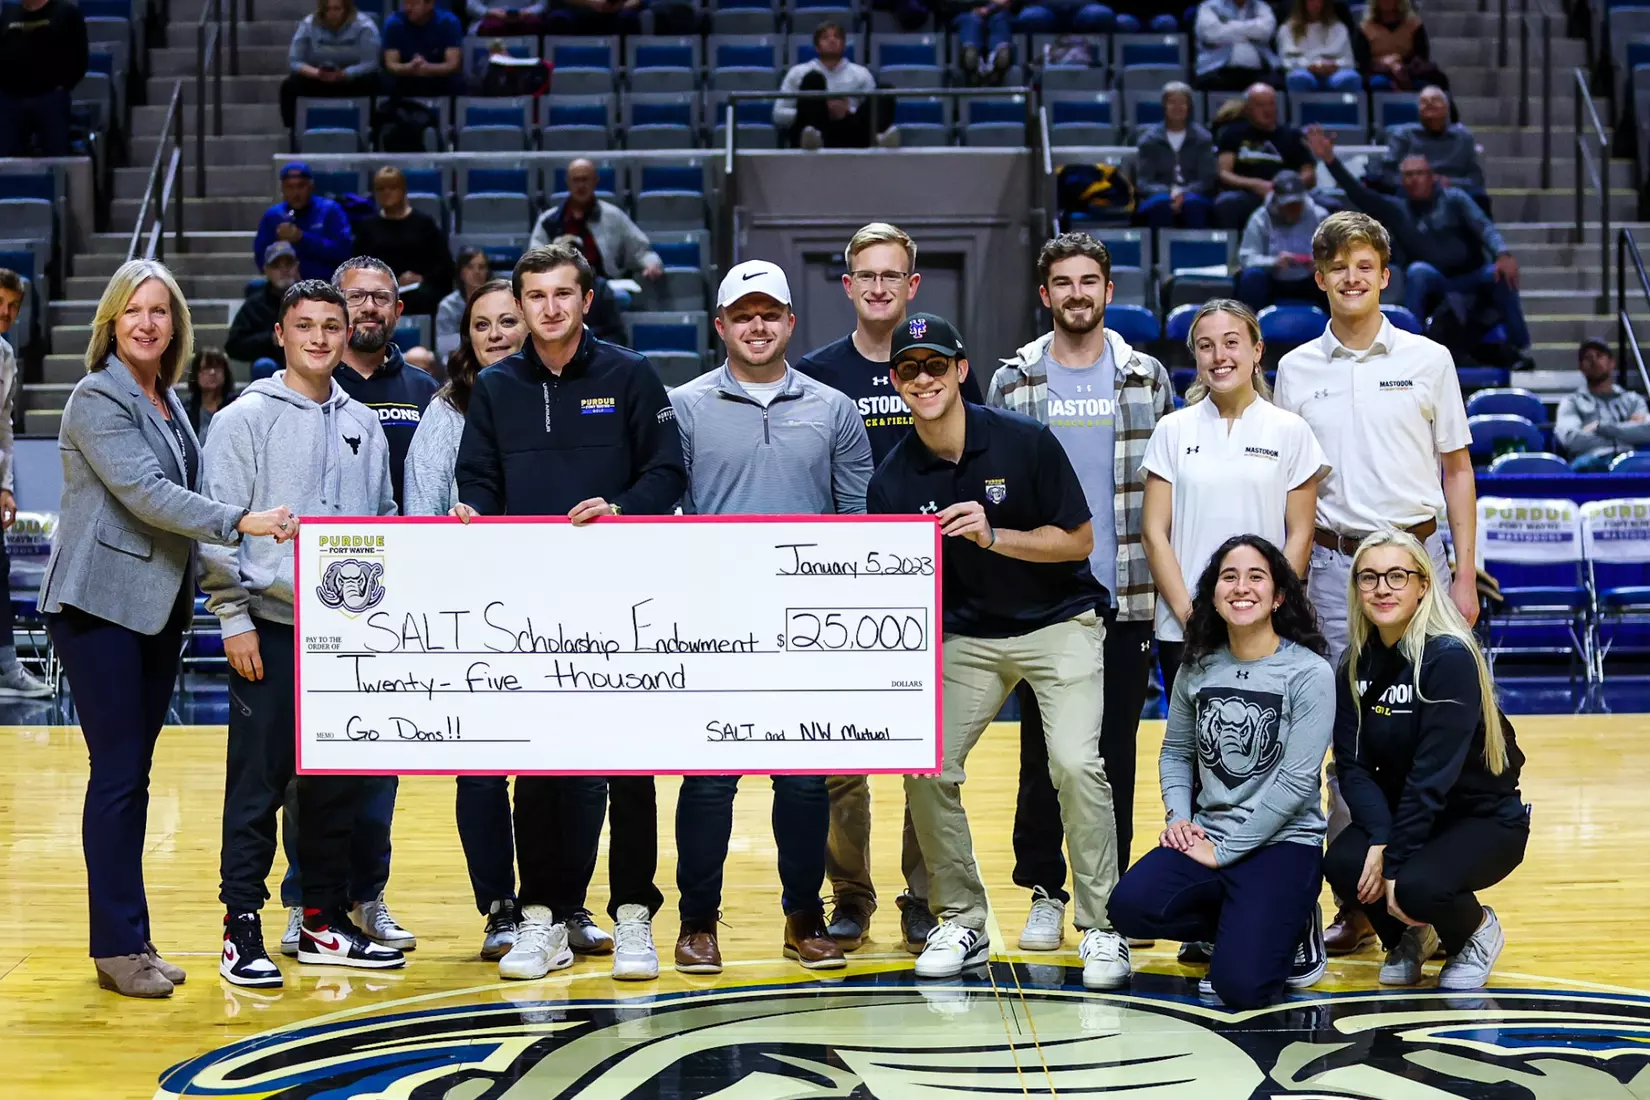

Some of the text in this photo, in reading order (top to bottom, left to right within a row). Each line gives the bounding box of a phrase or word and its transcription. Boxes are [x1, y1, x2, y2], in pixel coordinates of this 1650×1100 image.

[581, 398, 615, 406] PURDUE
[858, 395, 912, 416] STOD
[1047, 398, 1116, 416] ASTOD
[1245, 446, 1279, 457] MASTODON
[319, 535, 385, 547] PURDUE
[775, 543, 858, 578] January
[363, 597, 760, 661] SALT Scholarship Endowment
[791, 612, 924, 651] 25,000
[544, 659, 686, 690] thousand
[346, 715, 461, 742] Go Dons!!
[706, 720, 891, 742] SALT and NW Mutual
